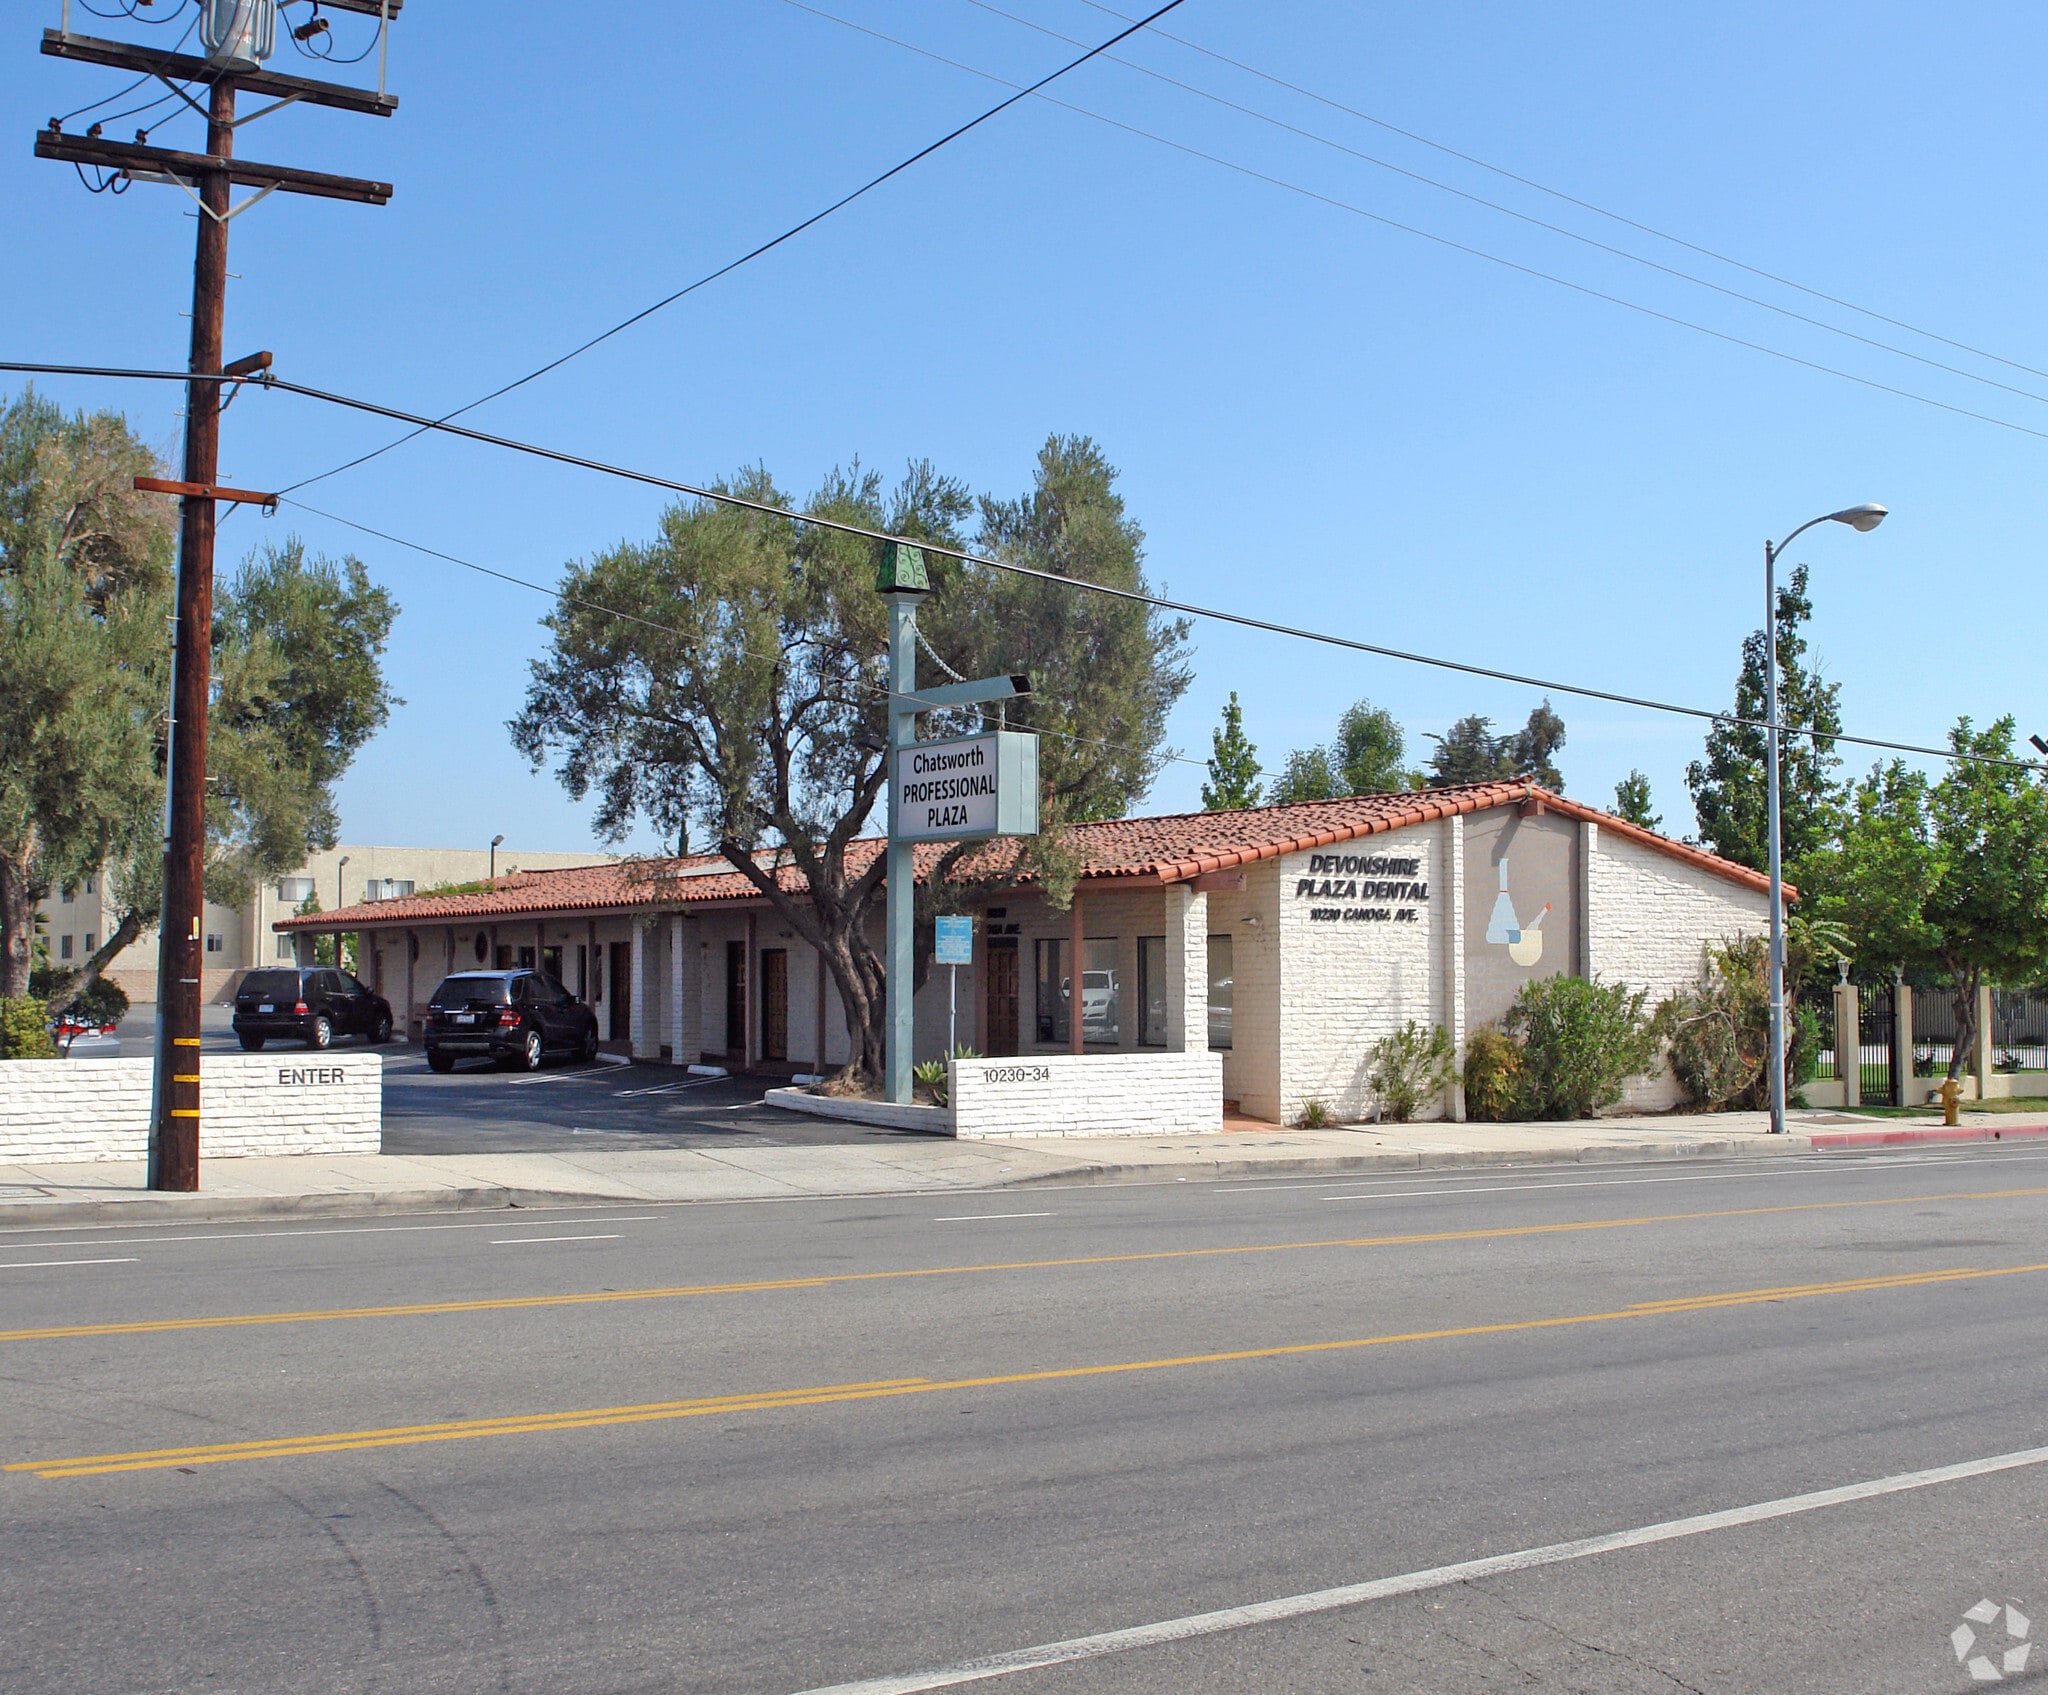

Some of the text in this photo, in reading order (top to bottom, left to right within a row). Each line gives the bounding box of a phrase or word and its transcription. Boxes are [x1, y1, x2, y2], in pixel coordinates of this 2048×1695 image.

[913, 745, 984, 774] Chatsworth
[903, 774, 996, 804] PROFESSIONAL
[927, 805, 968, 828] PLAZA
[1309, 855, 1420, 875] DEVONSHIRE
[1296, 878, 1430, 900] PLAZA DENTAL
[1310, 907, 1419, 921] 10230 CANOGA AVE.
[279, 1068, 344, 1084] ENTER
[983, 1068, 1049, 1083] 10230-34
